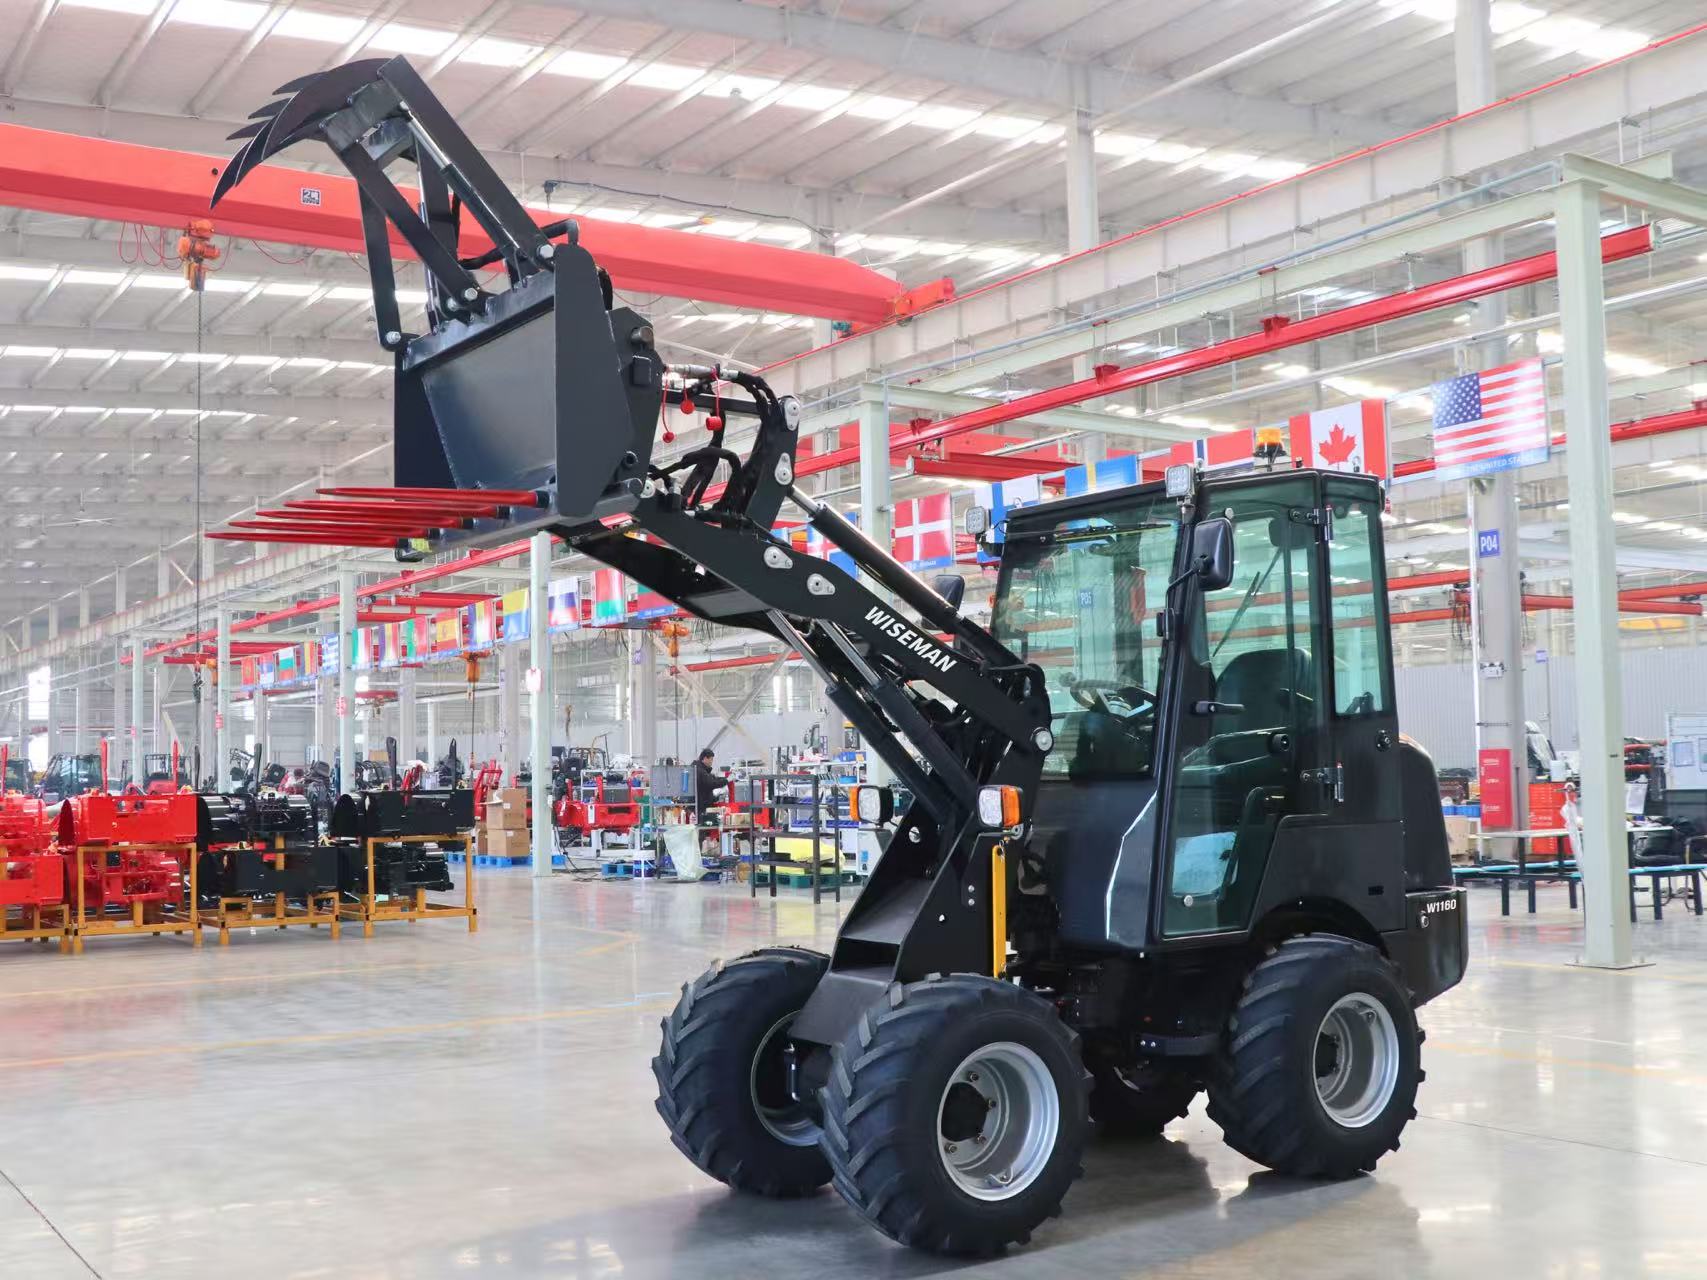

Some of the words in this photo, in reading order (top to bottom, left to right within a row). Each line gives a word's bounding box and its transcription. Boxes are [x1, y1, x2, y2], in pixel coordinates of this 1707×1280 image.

[1480, 534, 1498, 553] P04
[864, 606, 958, 673] WISEMAN
[1426, 899, 1457, 914] W1160
